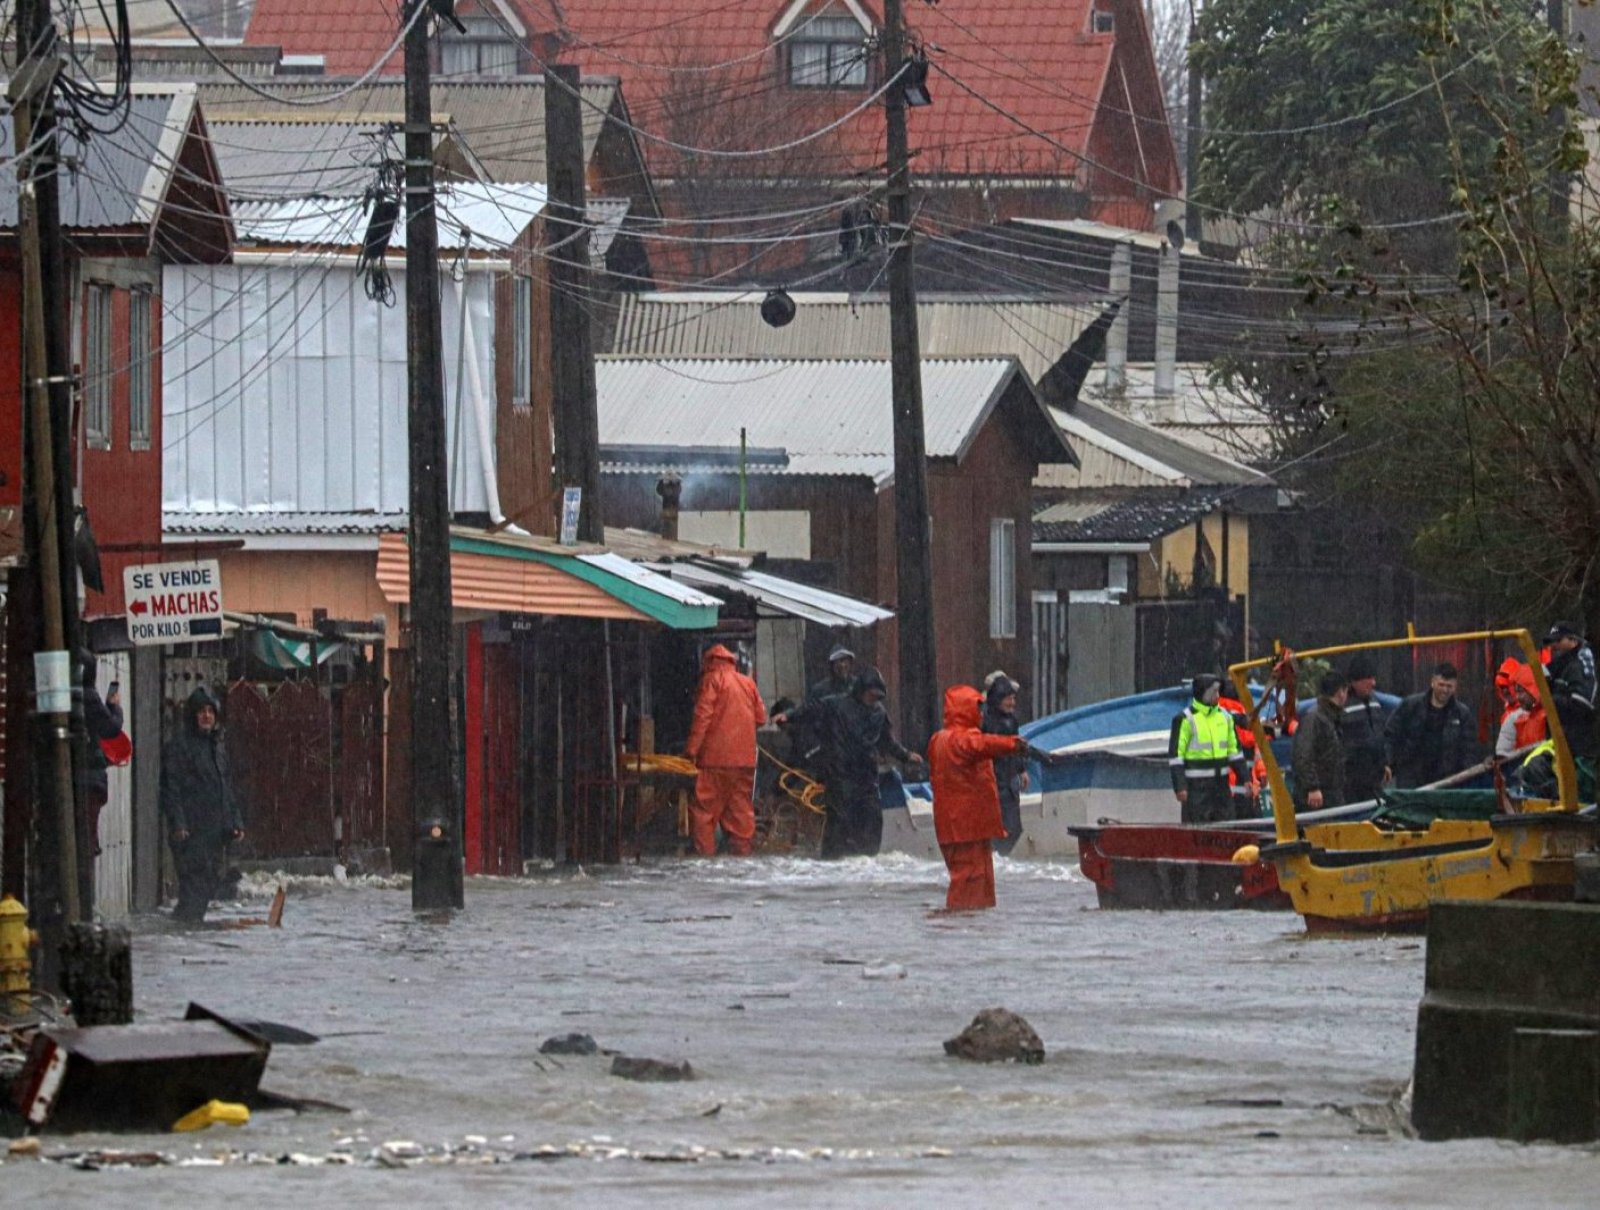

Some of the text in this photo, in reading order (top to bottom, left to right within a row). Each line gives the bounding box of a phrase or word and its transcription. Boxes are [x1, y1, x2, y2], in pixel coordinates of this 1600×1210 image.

[133, 569, 211, 589] SE VENDE
[151, 591, 219, 616] MACHAS
[132, 623, 154, 639] POR
[158, 621, 181, 637] KILO
